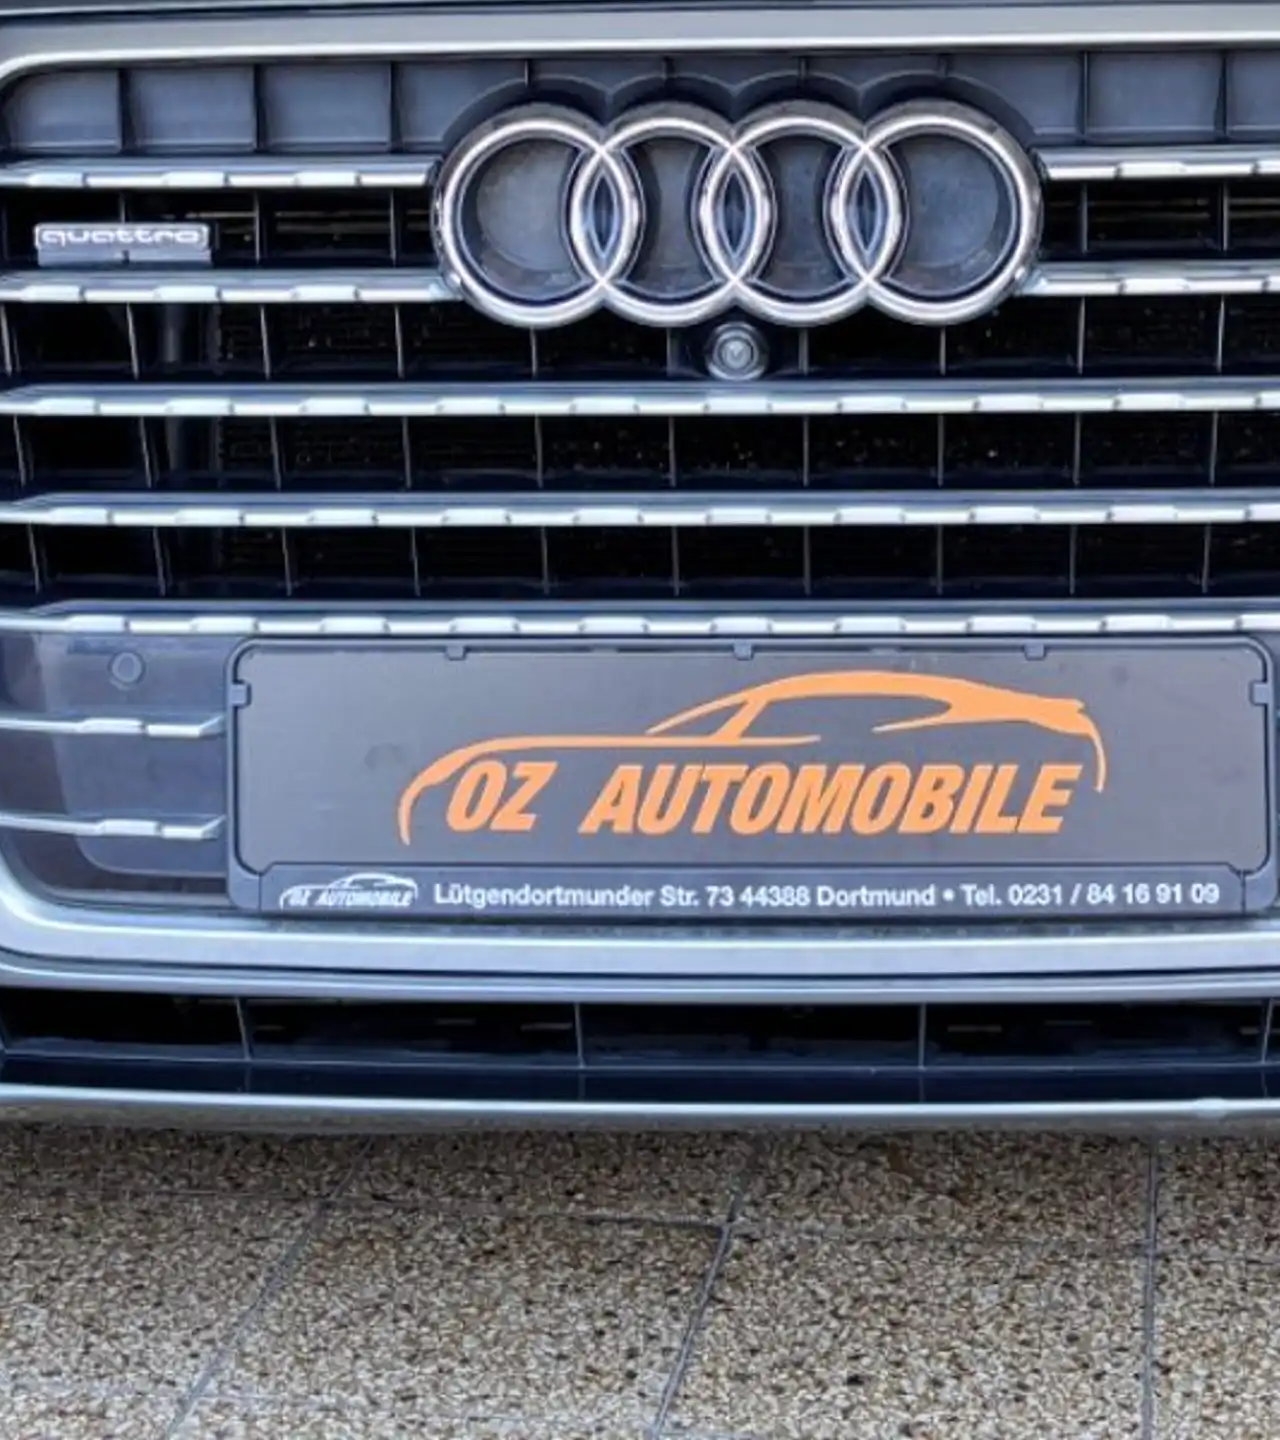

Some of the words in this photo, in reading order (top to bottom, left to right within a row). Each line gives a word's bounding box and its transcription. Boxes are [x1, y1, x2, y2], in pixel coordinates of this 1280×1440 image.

[41, 229, 200, 246] quattro
[446, 760, 558, 832] OZ
[577, 762, 1083, 835] AUTOMOBILE
[433, 883, 654, 910] Lütgendortmunder
[659, 884, 700, 907] Str.
[705, 885, 735, 908] 73
[739, 885, 811, 908] 44388
[816, 884, 936, 907] Dortmund
[959, 884, 1003, 906] Tel.
[1007, 883, 1064, 906] 0231
[1086, 883, 1117, 906] 84
[1122, 883, 1151, 905] 16
[1156, 883, 1183, 905] 91
[1189, 883, 1221, 905] 09
